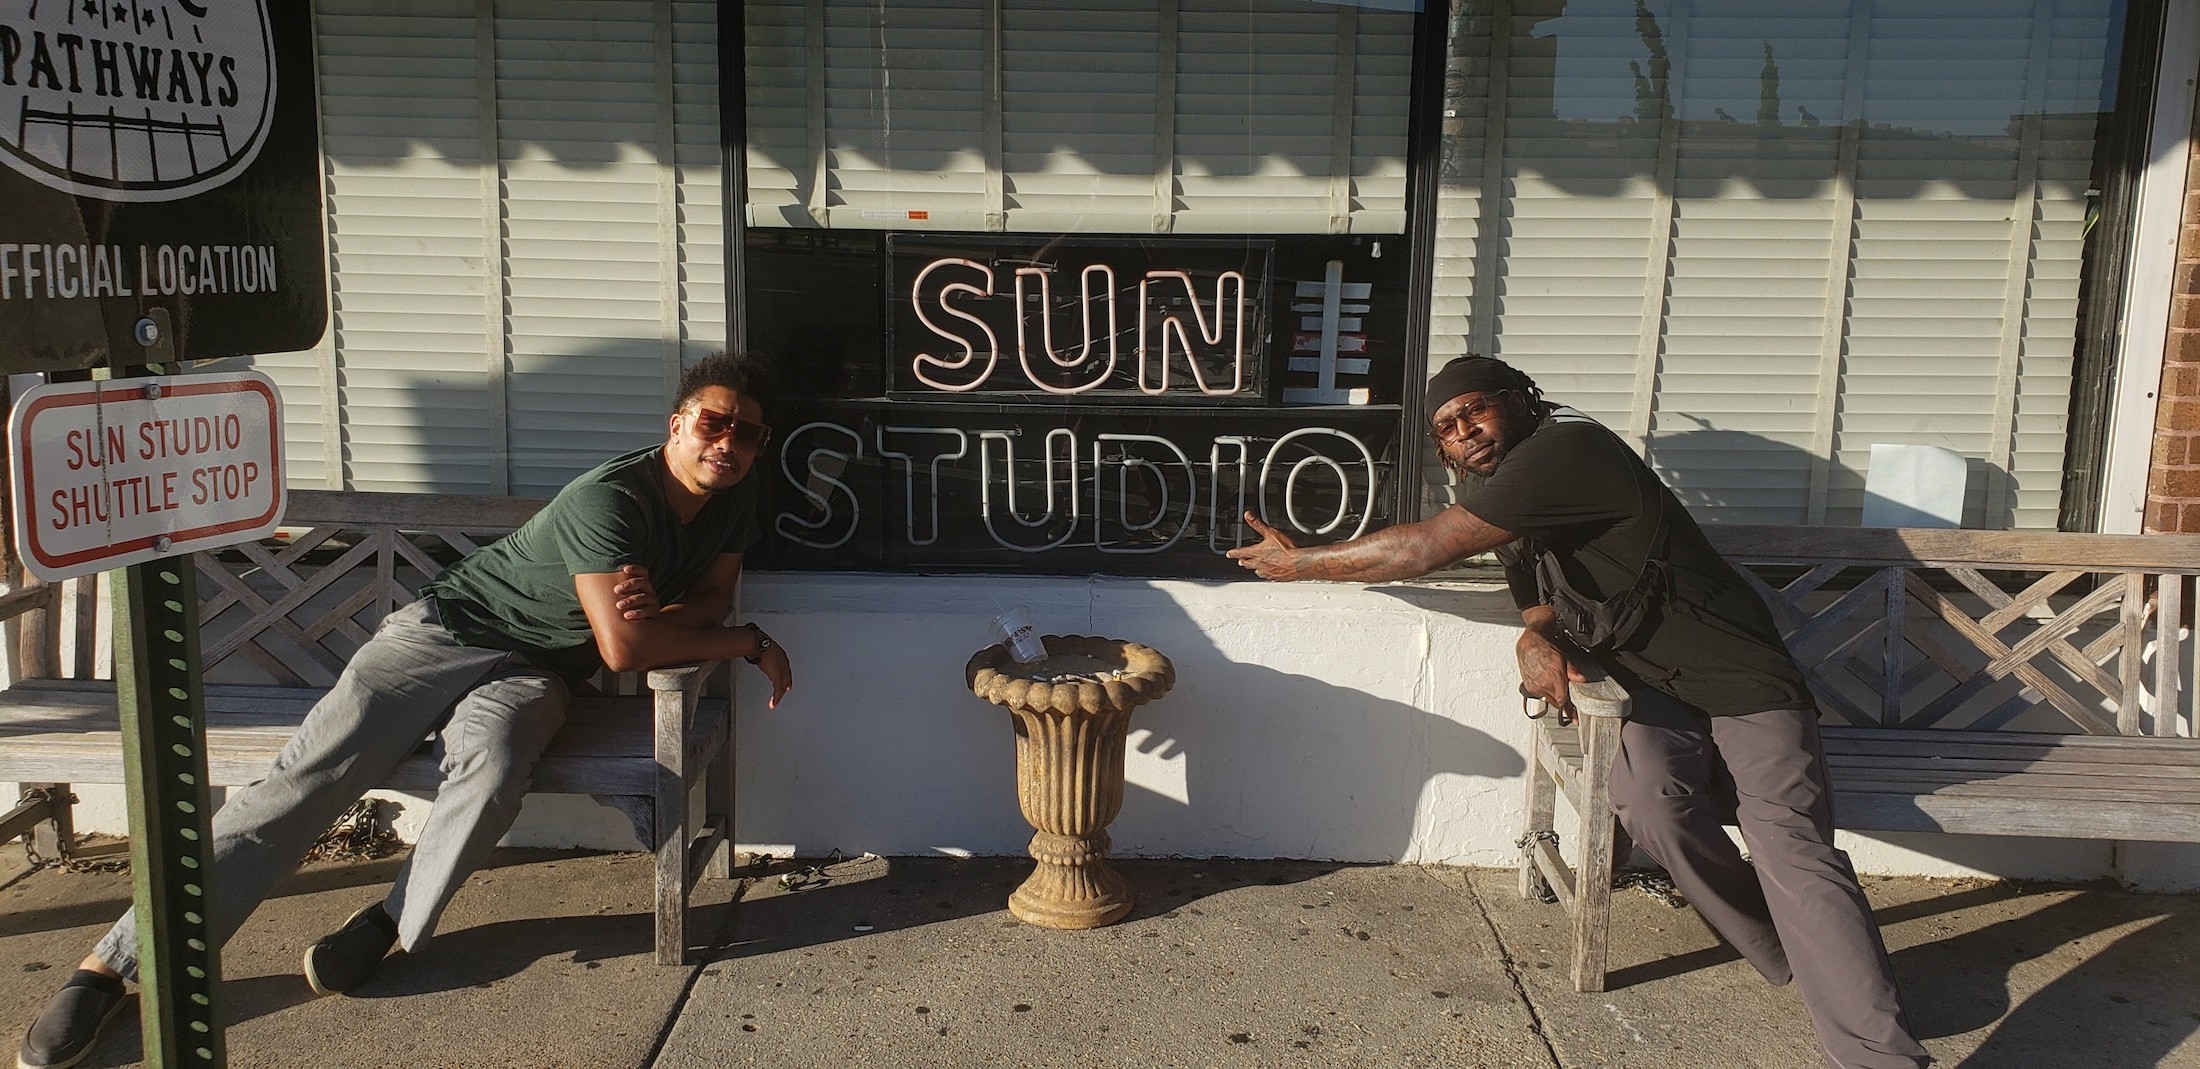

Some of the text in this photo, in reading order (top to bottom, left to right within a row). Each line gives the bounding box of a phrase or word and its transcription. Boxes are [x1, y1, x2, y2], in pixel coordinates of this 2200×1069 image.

[0, 24, 239, 108] PATHWAYS
[139, 244, 278, 296] LOCATION
[913, 257, 1245, 395] SUN
[66, 413, 242, 471] SUN STUDIO
[51, 461, 259, 530] SHUTTLE STOP
[775, 421, 1377, 555] STUDIO
